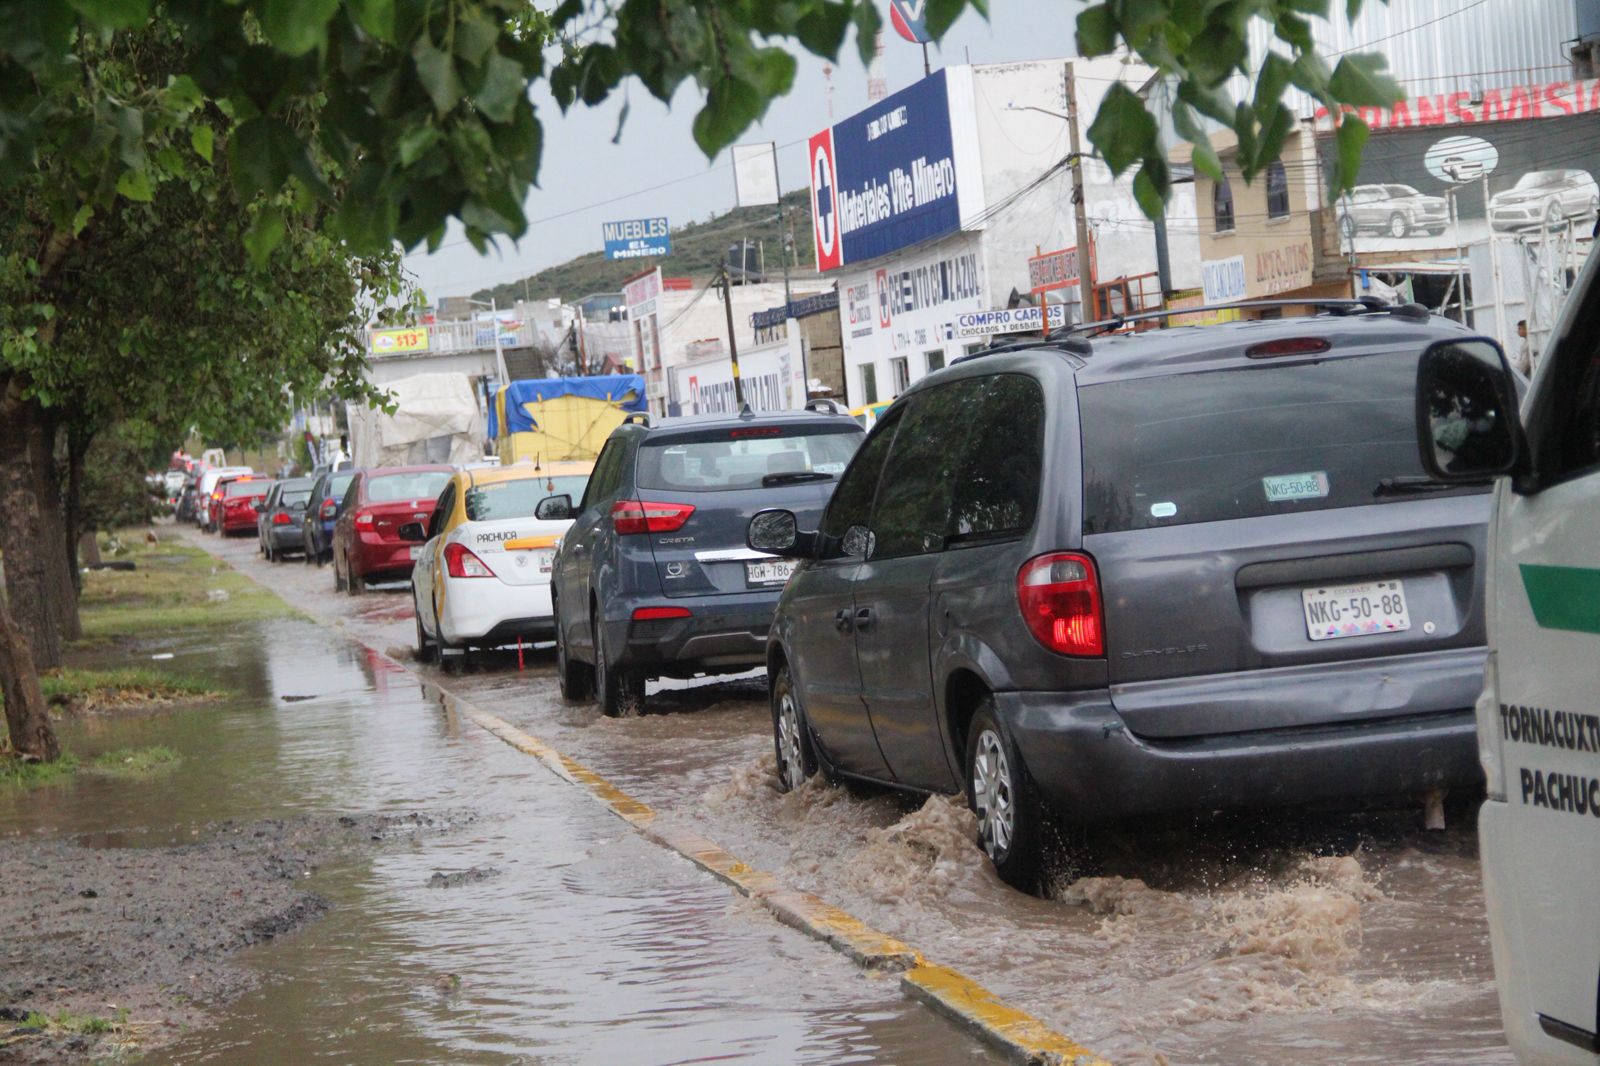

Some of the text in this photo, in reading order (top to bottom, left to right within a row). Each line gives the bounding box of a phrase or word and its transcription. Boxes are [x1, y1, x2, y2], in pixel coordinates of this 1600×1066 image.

[839, 178, 890, 234] Materiales
[912, 157, 954, 207] Minero
[604, 218, 667, 241] MUEBLES
[613, 246, 666, 259] MINERO
[629, 240, 649, 249] EL
[960, 311, 1010, 327] COMPRO
[961, 326, 999, 336] CHOCADOS
[1267, 481, 1320, 497] NKG-50-88
[477, 531, 517, 543] PACHUCA
[1308, 594, 1403, 624] NKG-50-88
